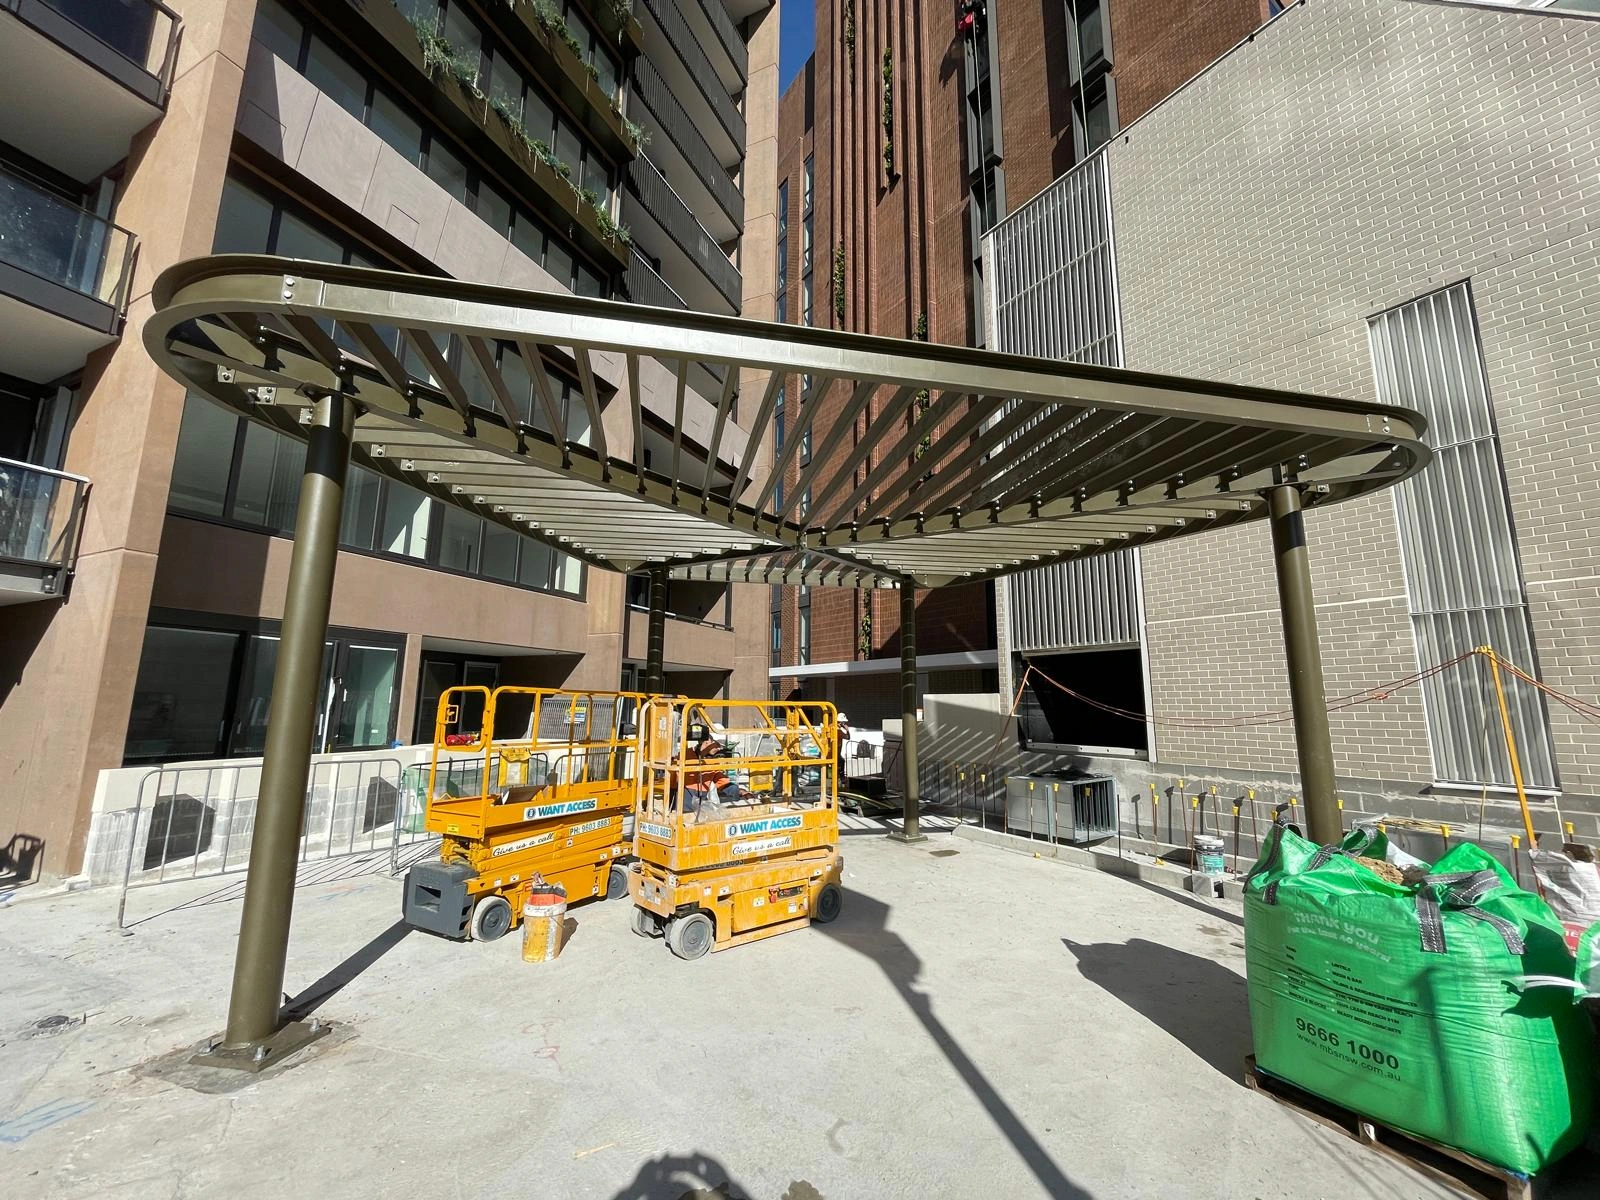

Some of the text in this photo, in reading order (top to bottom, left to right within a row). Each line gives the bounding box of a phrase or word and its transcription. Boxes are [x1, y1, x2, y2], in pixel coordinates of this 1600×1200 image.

[538, 799, 596, 817] WANT ACCESS
[597, 819, 611, 830] 8883
[740, 816, 802, 834] WANT ACCESS
[492, 846, 515, 858] Give
[516, 842, 527, 850] us
[537, 832, 554, 844] call
[732, 845, 753, 856] Give
[775, 836, 792, 847] call
[1295, 1017, 1400, 1070] 9666 1000
[1296, 1032, 1401, 1081] www.mbsnsw.com.au
